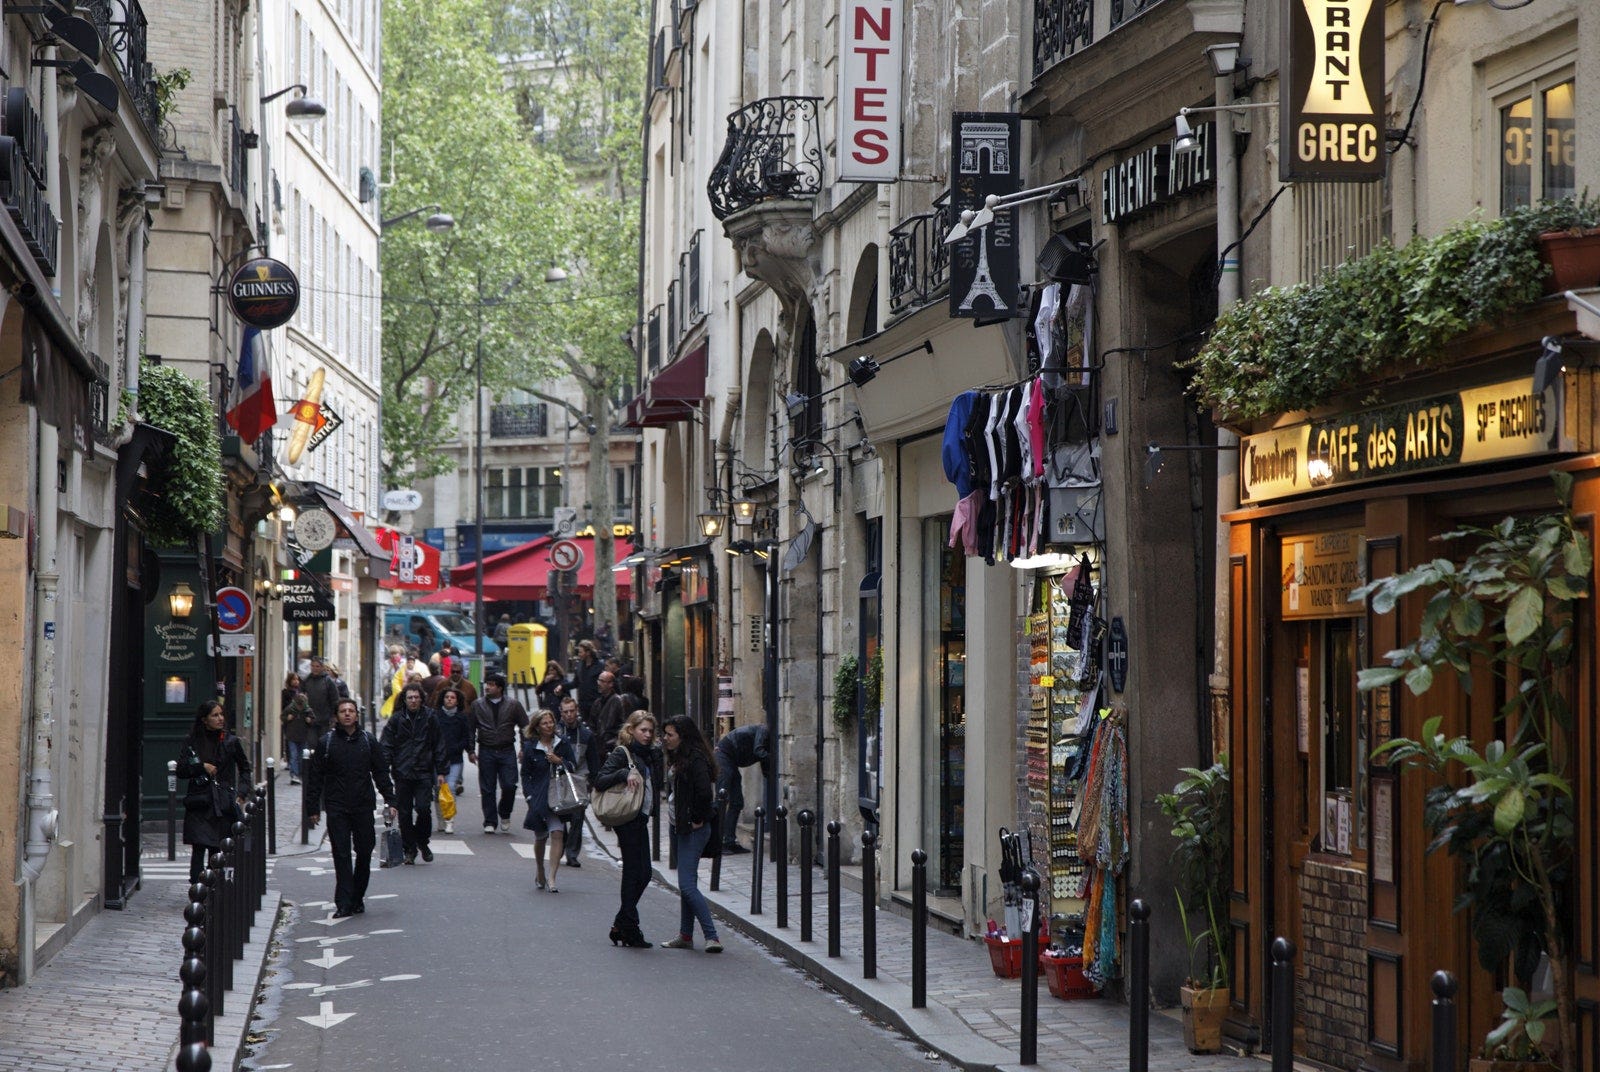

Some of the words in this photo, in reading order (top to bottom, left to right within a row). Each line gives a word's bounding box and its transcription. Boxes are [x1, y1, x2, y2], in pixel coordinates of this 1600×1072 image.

[1325, 0, 1350, 100] RANT
[1298, 122, 1377, 162] GREC
[1102, 145, 1158, 224] EUGENIE
[1168, 121, 1210, 195] HOTEL
[233, 282, 295, 297] GUINNESS
[1500, 390, 1547, 439] GRECQUES
[1367, 422, 1397, 470] des
[1404, 403, 1453, 462] ARTS
[283, 585, 315, 593] PIZZA
[283, 595, 316, 604] PASTA
[293, 610, 328, 618] PANINI
